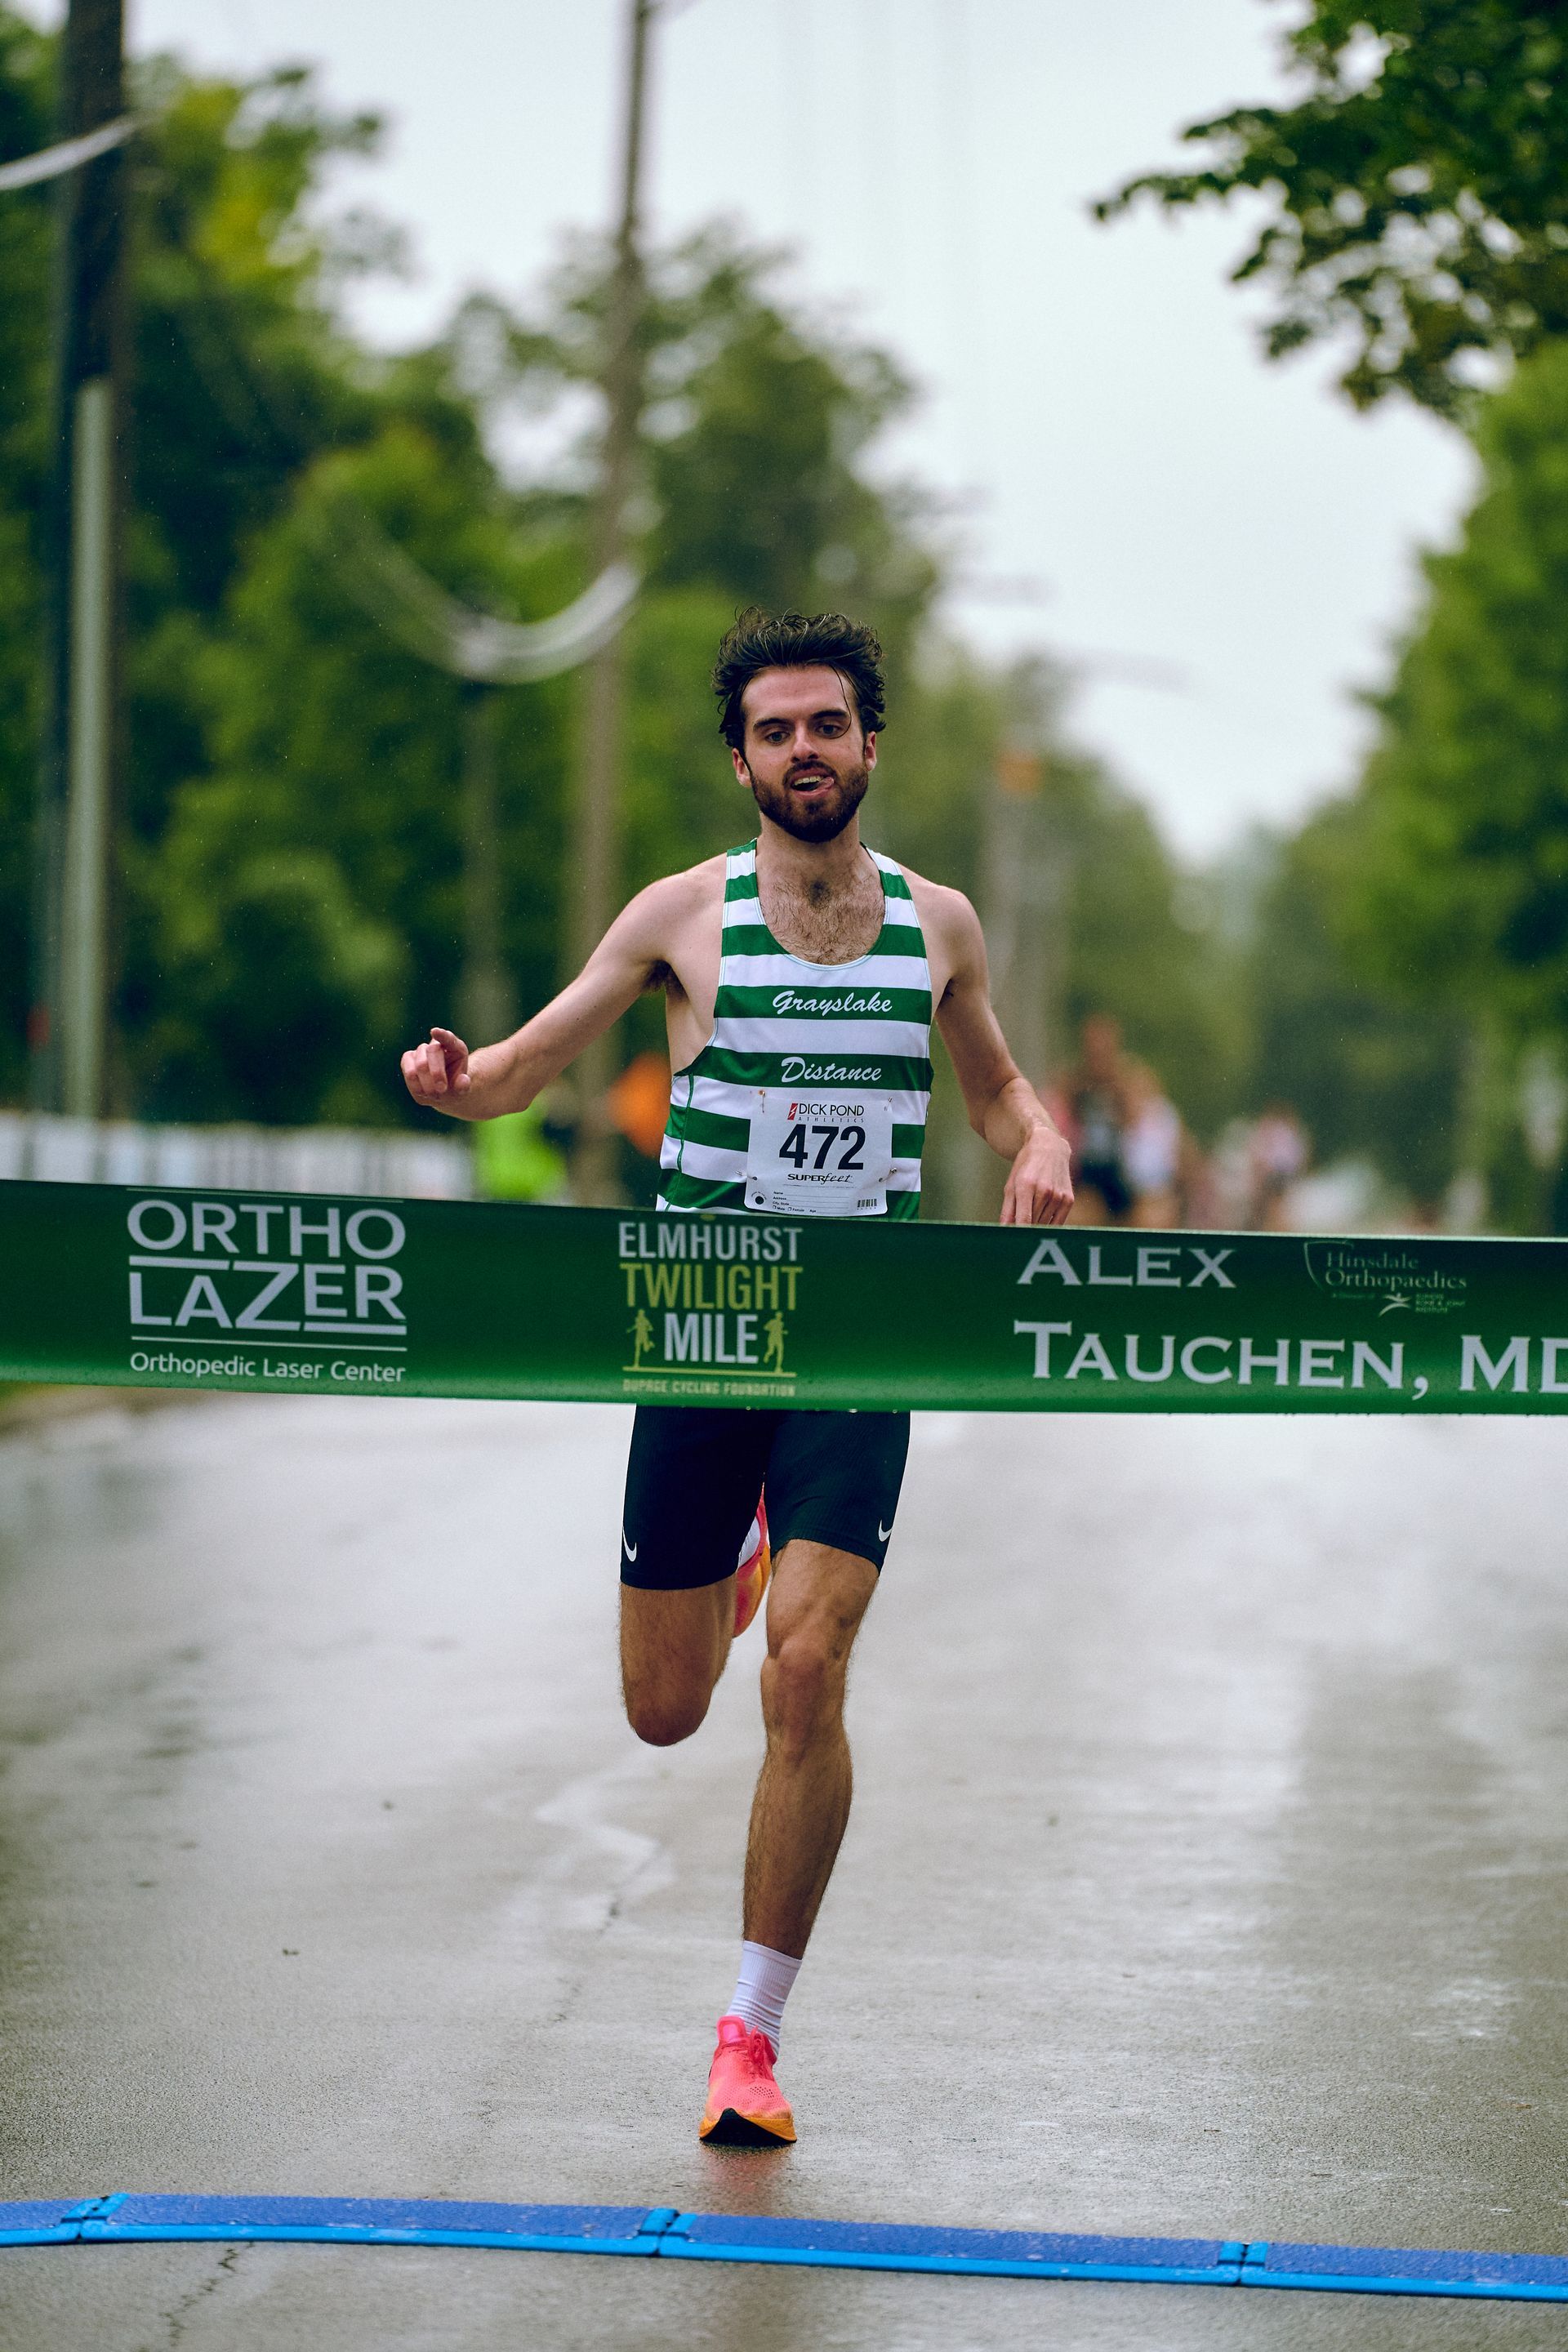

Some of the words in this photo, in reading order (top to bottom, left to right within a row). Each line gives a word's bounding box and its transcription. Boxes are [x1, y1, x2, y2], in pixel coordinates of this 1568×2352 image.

[773, 990, 893, 1017] Grayslake
[781, 1056, 882, 1083] Distance
[799, 1103, 827, 1116] DICK
[830, 1104, 865, 1116] POND
[778, 1124, 866, 1170] 472
[127, 1199, 407, 1259] ORTHO
[618, 1222, 804, 1262] ELMHURST
[1017, 1238, 1236, 1289] ALEX
[1325, 1268, 1468, 1292] Orthopaedics
[1327, 1252, 1419, 1269] Hinsdale
[129, 1260, 407, 1330] LAZER
[619, 1263, 804, 1311] TWILIGHT
[664, 1312, 760, 1365] MILE
[1013, 1319, 1429, 1401] TAUCHEN,
[130, 1352, 256, 1379] Orthopedic
[263, 1357, 324, 1379] Laser
[330, 1361, 407, 1383] Center
